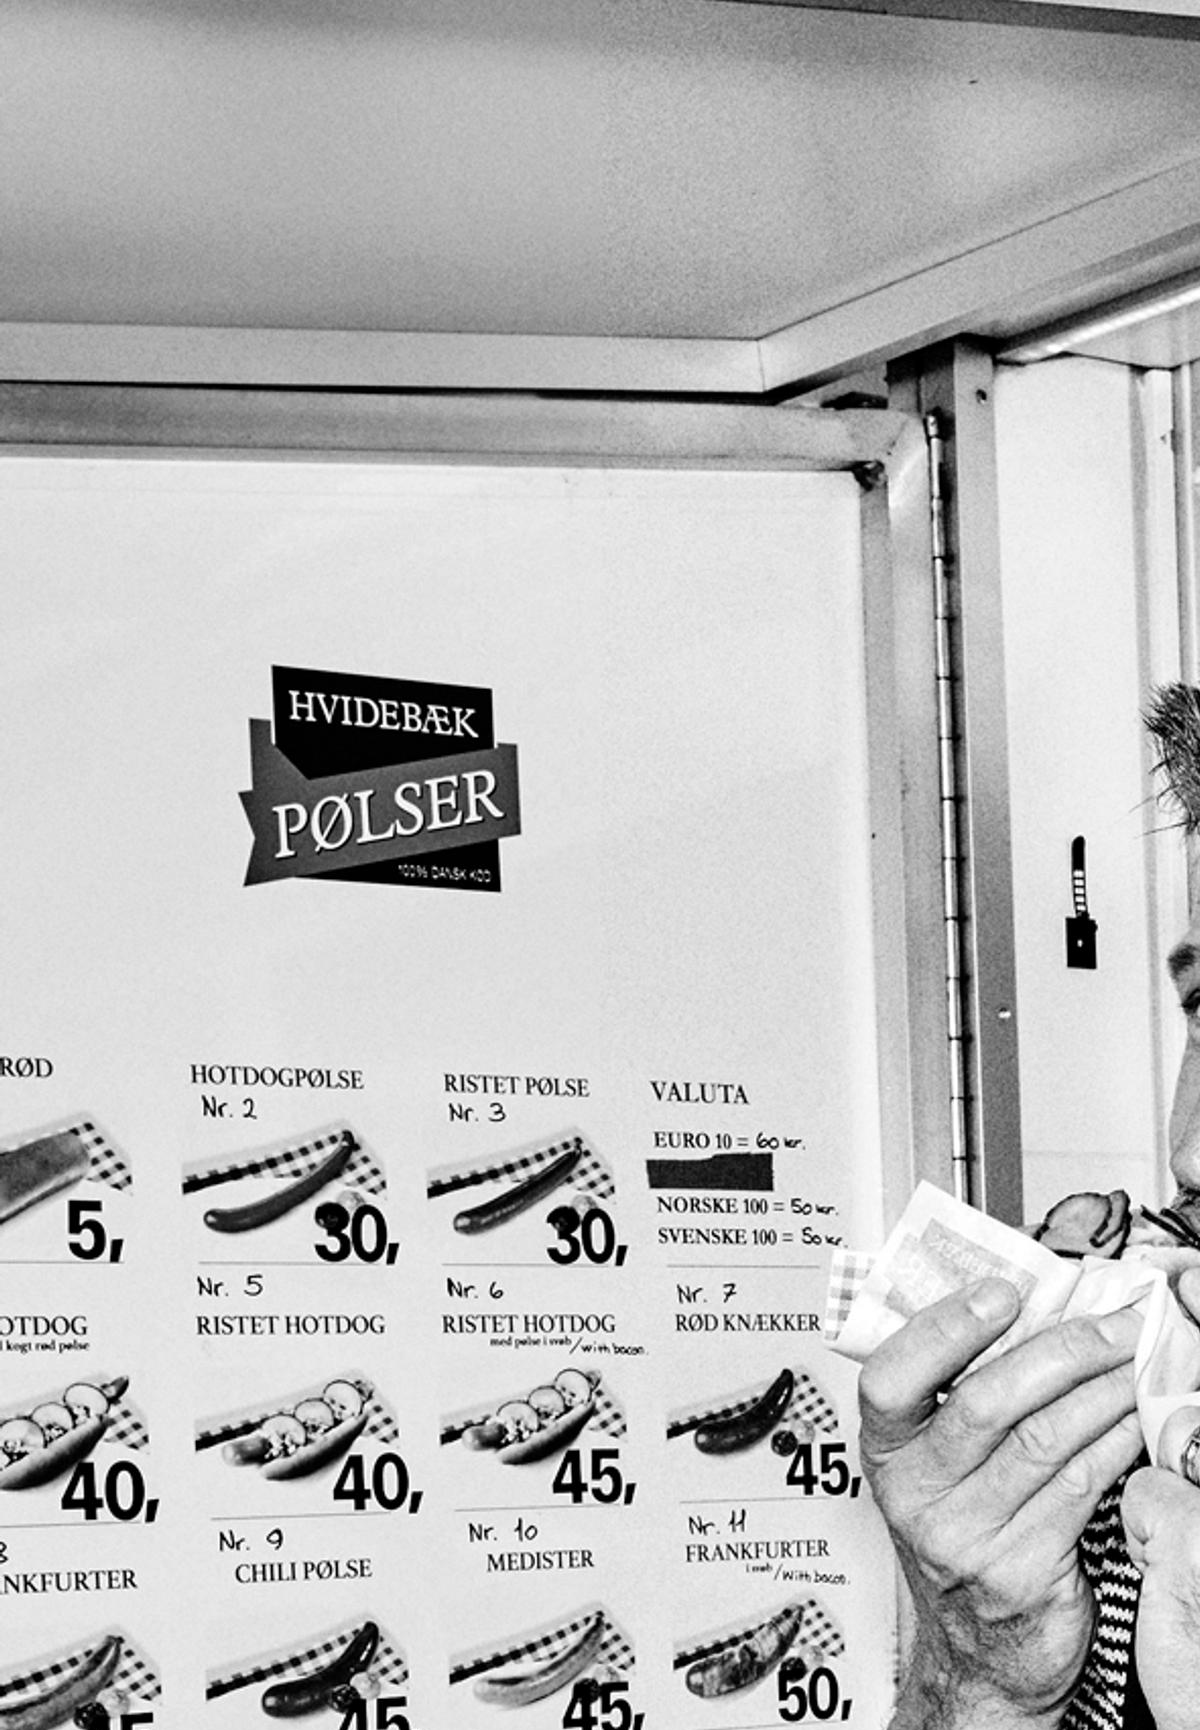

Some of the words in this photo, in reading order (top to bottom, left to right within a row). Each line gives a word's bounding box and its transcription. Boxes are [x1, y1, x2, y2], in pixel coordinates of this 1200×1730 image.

[288, 690, 478, 737] HVIDEBÆK
[272, 770, 504, 859] PØLSER
[190, 1064, 364, 1089] HOTDOGPØLSE
[443, 1073, 520, 1095] RISTET
[525, 1076, 590, 1097] PØLSE
[650, 1081, 750, 1105] VALUTA
[201, 1095, 233, 1119] Nr.
[243, 1098, 258, 1120] 2
[449, 1103, 478, 1123] Nr.
[488, 1102, 506, 1123] 3
[653, 1131, 710, 1149] EURO
[716, 1133, 732, 1149] 10
[657, 1196, 738, 1214] NORSKE
[743, 1198, 768, 1215] 100
[658, 1227, 747, 1245] SVENSKE
[752, 1229, 777, 1246] 100
[197, 1276, 228, 1298] Nr.
[243, 1275, 264, 1297] 5
[447, 1277, 478, 1299] Nr.
[488, 1281, 504, 1299] 6
[677, 1284, 707, 1304] Nr.
[722, 1283, 738, 1301] 7
[197, 1315, 279, 1336] RISTET
[284, 1315, 386, 1336] HOTDOG
[442, 1313, 518, 1334] RISTET
[523, 1313, 616, 1334] HOTDOG
[675, 1312, 718, 1333] RØD
[723, 1312, 821, 1333] KNÆKKER
[468, 1521, 498, 1544] Nr.
[688, 1513, 720, 1537] Nr.
[218, 1529, 251, 1553] Nr.
[265, 1528, 285, 1551] 9
[685, 1539, 831, 1563] FRANKFURTER
[235, 1560, 297, 1584] CHILI
[303, 1557, 373, 1581] PØLSE
[486, 1549, 595, 1573] MEDISTER
[0, 1568, 138, 1595] NKFURTER
